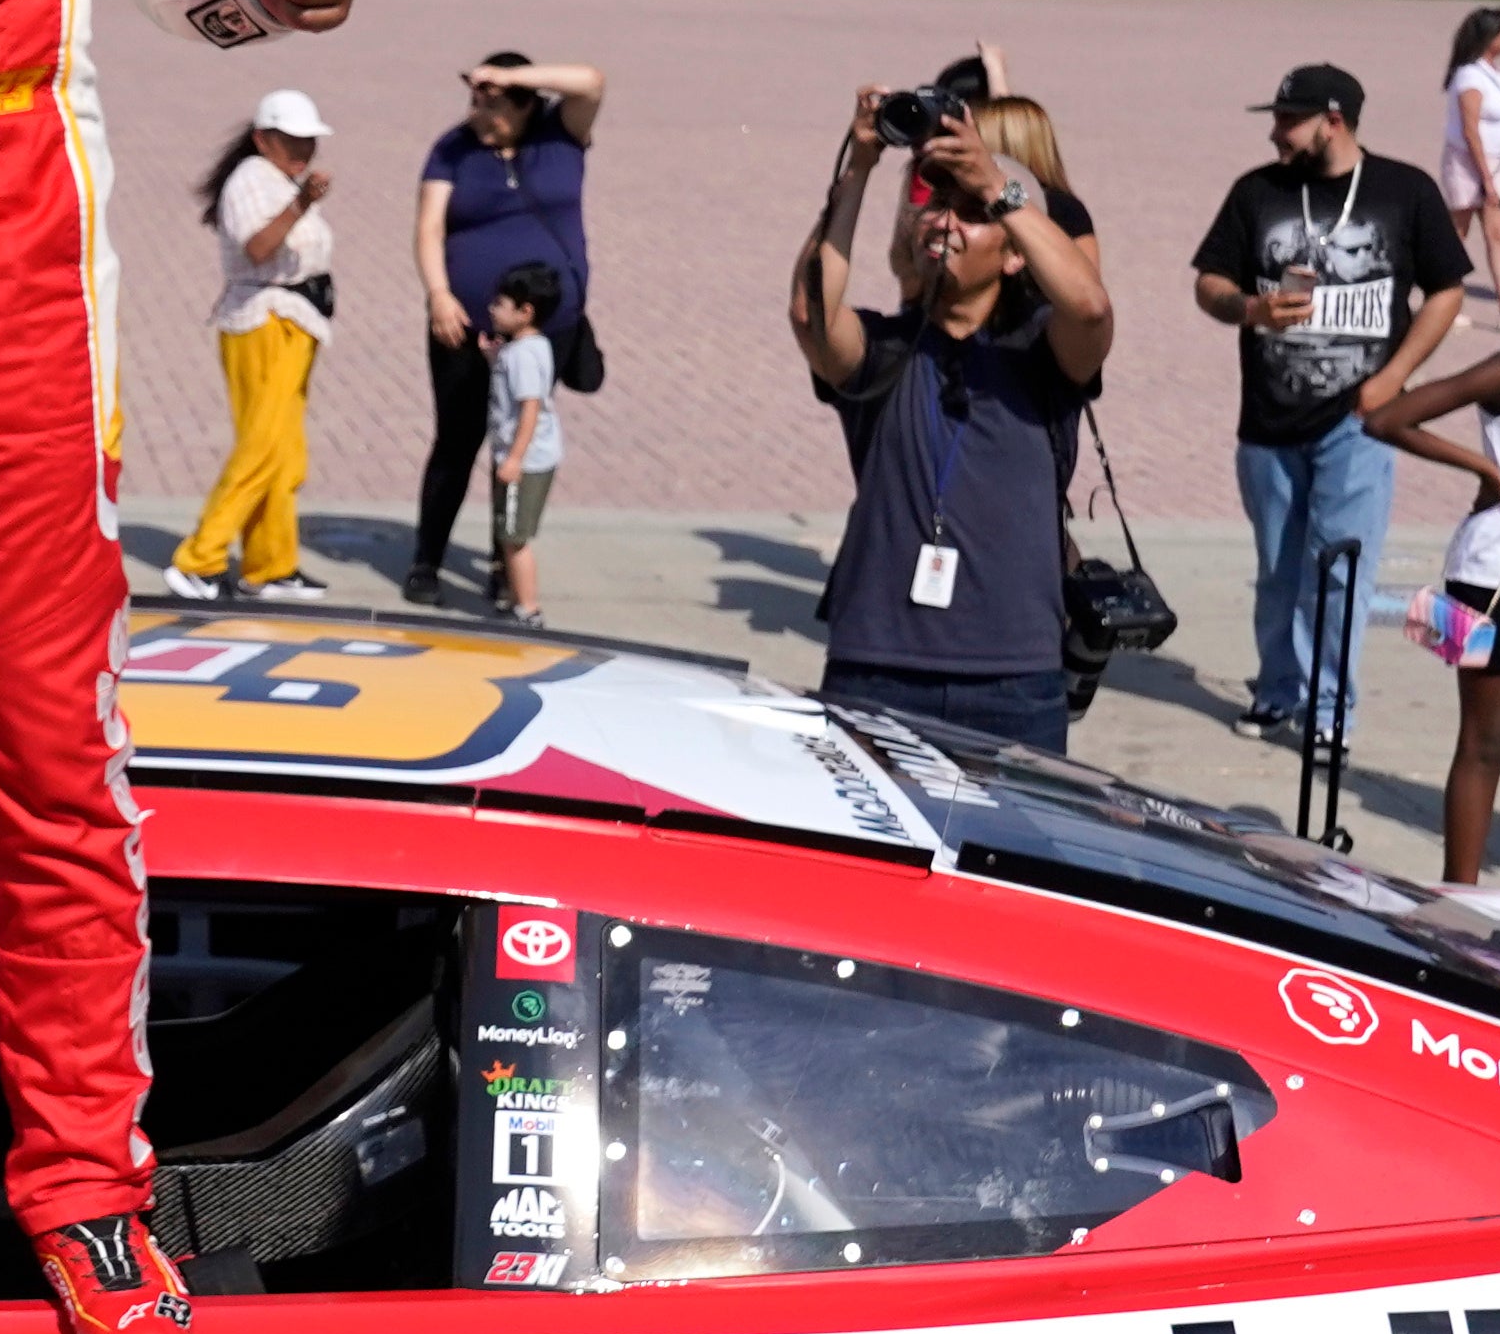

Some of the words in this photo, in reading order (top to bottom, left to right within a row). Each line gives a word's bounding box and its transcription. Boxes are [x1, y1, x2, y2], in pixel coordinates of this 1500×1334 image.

[1321, 282, 1389, 330] LOCOS
[477, 1025, 578, 1047] MoneyLion
[486, 1077, 576, 1096] DRAFT
[496, 1090, 576, 1111] KINGS
[508, 1116, 555, 1131] Mobil
[520, 1134, 540, 1175] 1
[489, 1186, 566, 1224] MAC
[489, 1221, 566, 1239] TOOLS
[483, 1251, 571, 1287] 23XI
